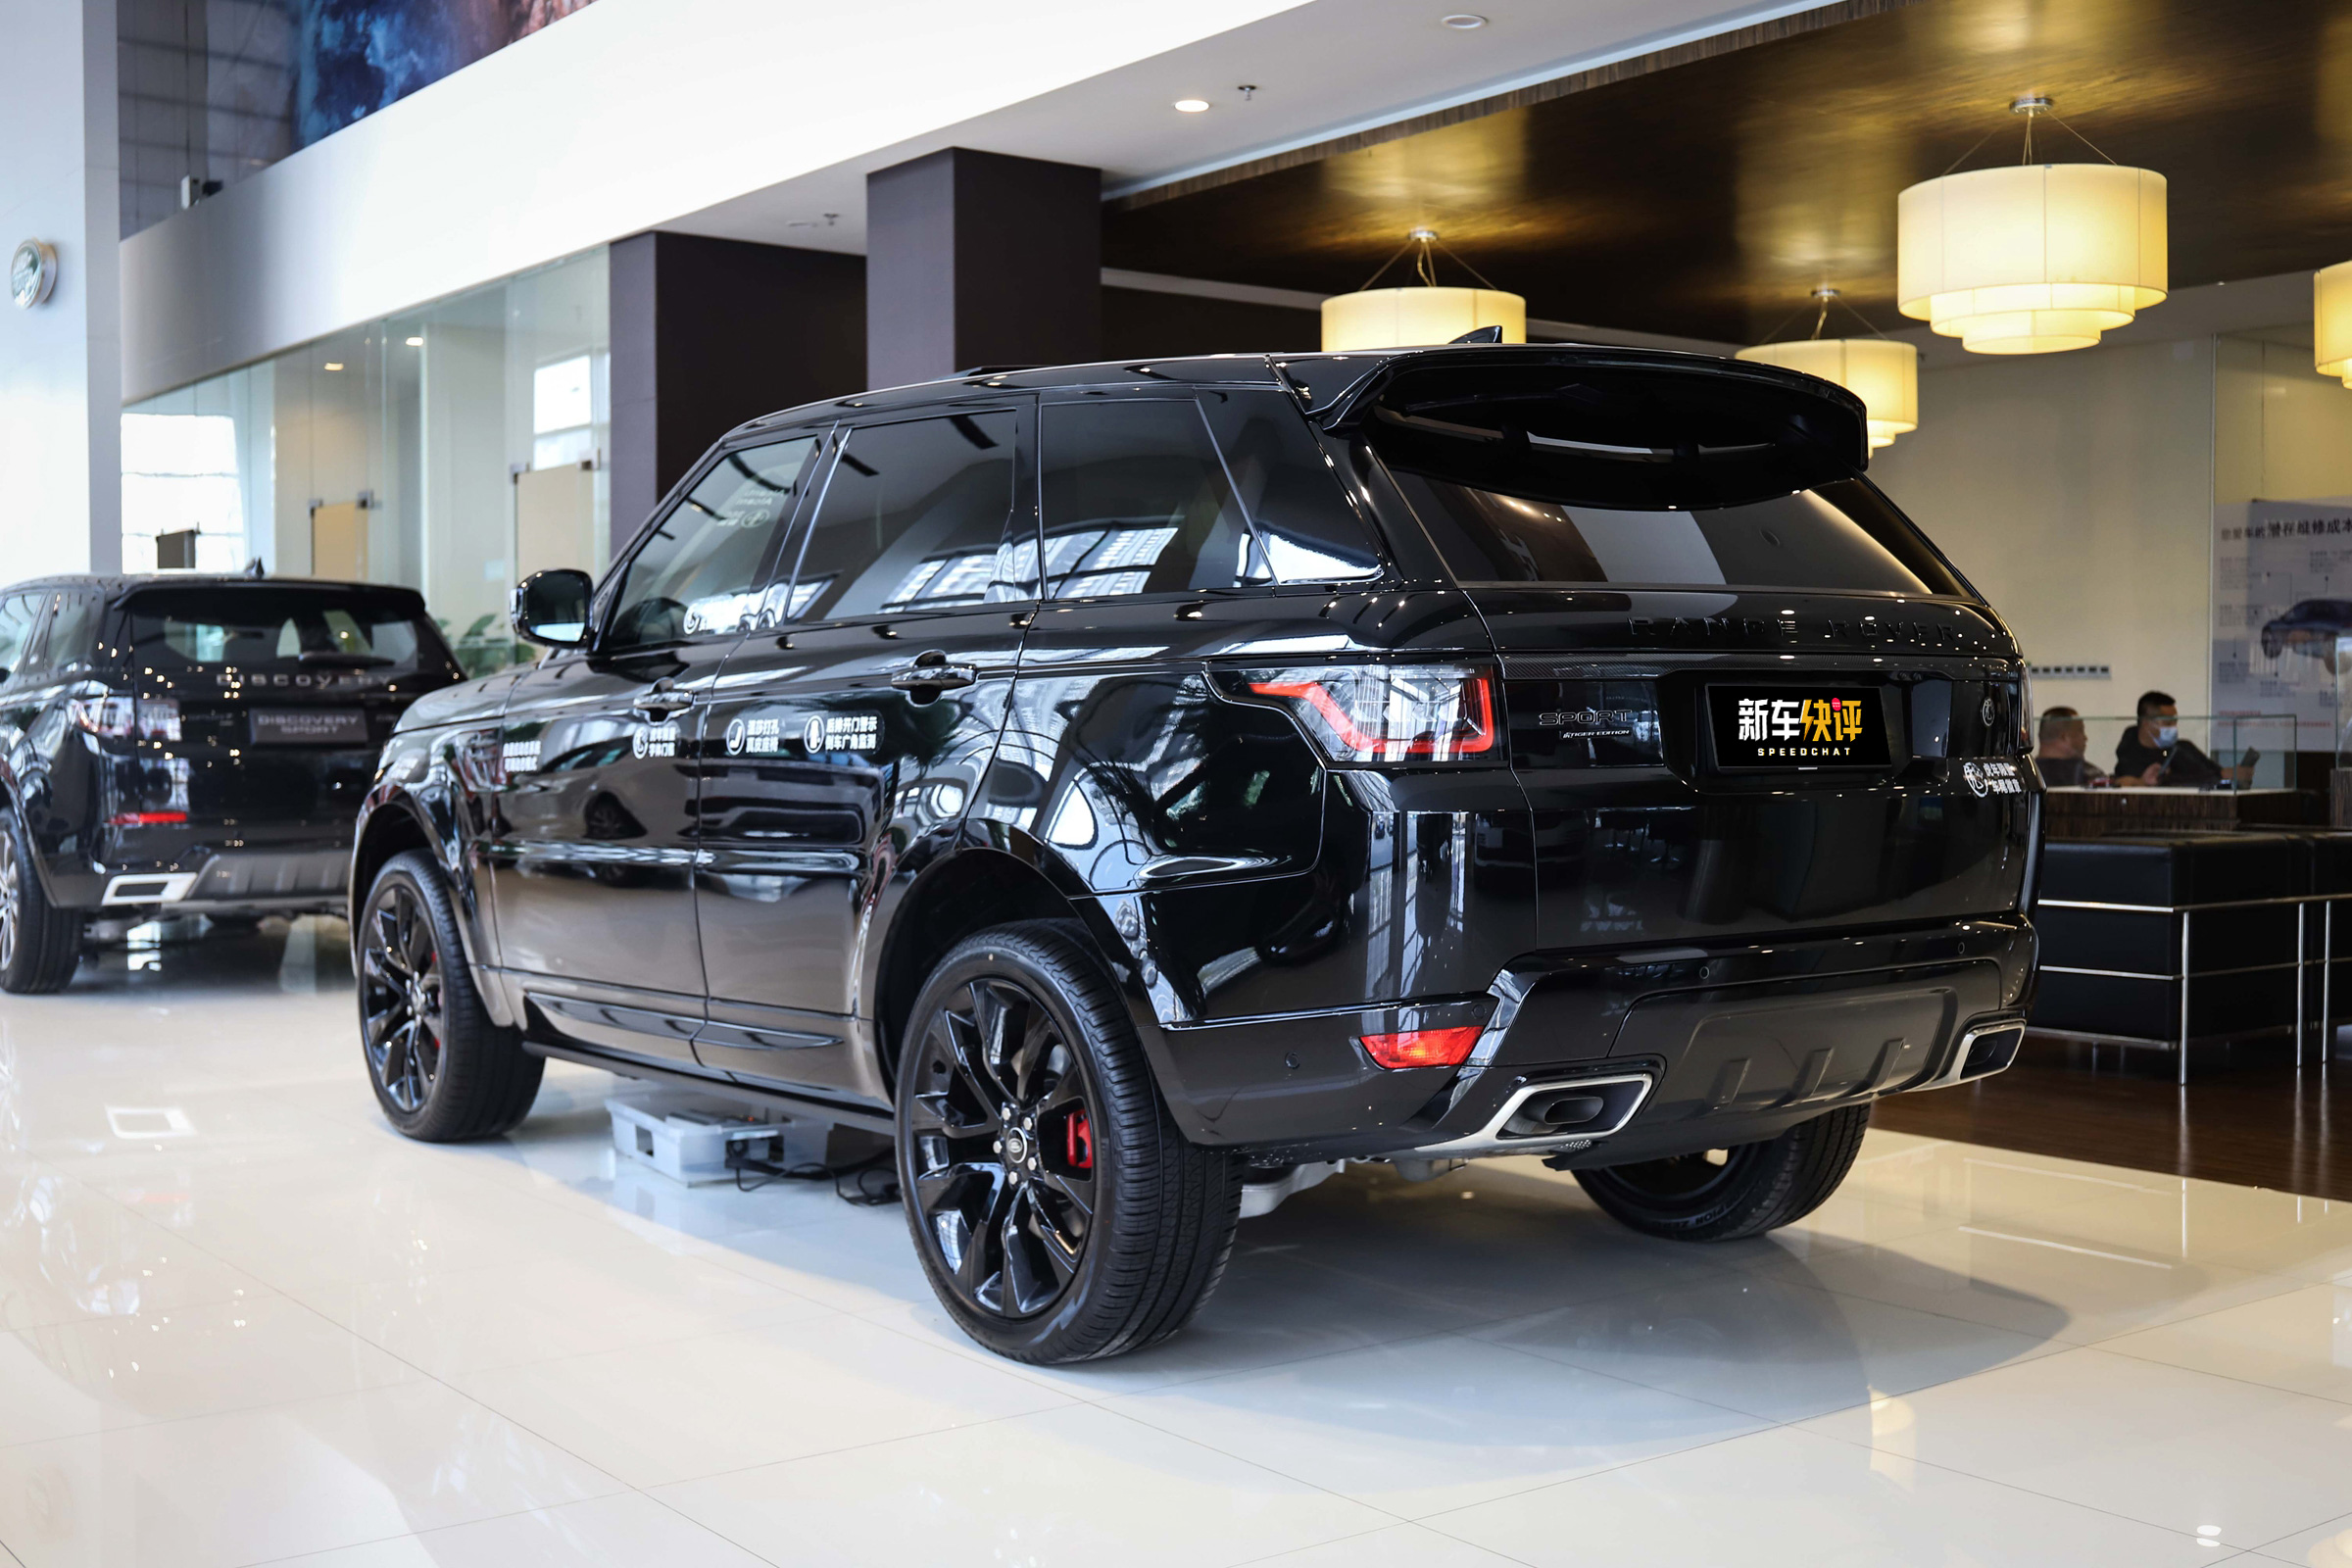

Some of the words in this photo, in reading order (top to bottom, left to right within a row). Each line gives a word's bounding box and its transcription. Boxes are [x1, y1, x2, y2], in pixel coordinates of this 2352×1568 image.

[1628, 616, 1798, 637] RANGE
[1828, 619, 1953, 641] ROVER
[216, 673, 392, 687] DISCOVERY
[258, 714, 359, 726] DISCOVERY
[1539, 710, 1632, 725] SPORT
[280, 725, 339, 735] SPORT
